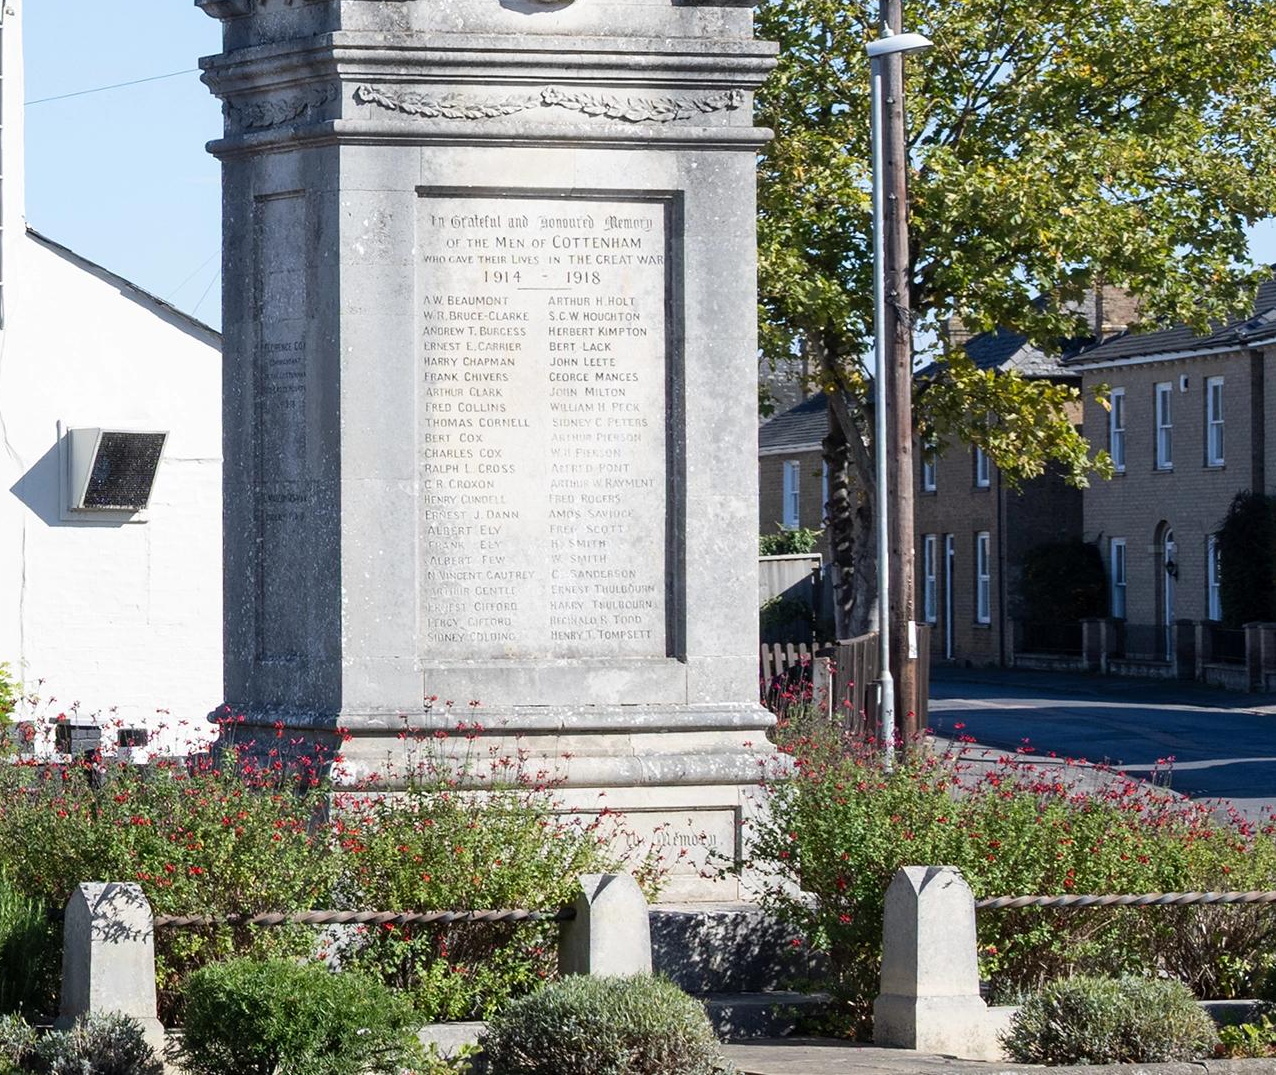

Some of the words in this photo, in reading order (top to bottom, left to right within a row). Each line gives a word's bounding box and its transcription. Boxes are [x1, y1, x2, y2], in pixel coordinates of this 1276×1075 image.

[451, 214, 501, 228] Grateful
[508, 214, 529, 228] and
[539, 214, 595, 228] Honoured
[604, 214, 654, 232] Memory
[467, 235, 490, 249] THE
[552, 235, 642, 249] COTTENHAM
[423, 254, 446, 265] WHO
[449, 254, 474, 265] GAVE
[477, 254, 507, 265] THEIR
[512, 254, 540, 265] LIVES
[569, 254, 593, 265] THE
[596, 254, 632, 265] GREAT
[635, 254, 664, 265] WAR
[484, 270, 522, 284] 1914
[567, 271, 602, 285] 1918
[447, 295, 509, 306] BEAUMONT
[548, 296, 591, 306] ARTHUR
[608, 296, 637, 306] HOLT
[449, 311, 530, 321] BRUCE-CLARKE
[583, 311, 641, 322] HOUGHTON
[422, 326, 465, 336] ANDREW
[480, 326, 527, 336] BURGESS
[549, 326, 594, 337] HERBERT
[598, 326, 648, 337] KIMPTON
[424, 341, 461, 351] ERNEST
[478, 341, 522, 351] CARRIER
[549, 342, 575, 352] BERT
[583, 342, 612, 352] LACK
[424, 357, 458, 367] HARRY
[463, 357, 516, 367] CHAPMAN
[549, 357, 578, 367] JOHN
[583, 357, 616, 367] LEETE
[424, 371, 459, 382] FRANK
[464, 371, 509, 382] CHIVERS
[549, 372, 589, 382] GEORGE
[426, 387, 464, 397] ARTHUR
[469, 387, 504, 397] CLARK
[549, 387, 578, 397] JOHN
[585, 387, 626, 397] MILTON
[425, 402, 452, 413] FRED
[458, 402, 507, 413] COLLINS
[550, 402, 594, 413] WILLIAM
[612, 402, 641, 413] PECK
[425, 417, 473, 428] THOMAS
[478, 417, 530, 428] CORNELL
[552, 418, 592, 428] SIDNEY
[607, 418, 649, 428] PETERS
[425, 433, 451, 443] BERT
[459, 433, 483, 443] COX
[424, 448, 474, 458] CHARLES
[479, 448, 502, 458] COX
[425, 463, 459, 473] RALPH
[478, 463, 516, 473] CROSS
[599, 463, 630, 473] PONT
[448, 478, 495, 489] CROXON
[424, 494, 457, 505] HENRY
[549, 494, 575, 504] FRED
[425, 510, 465, 520] ERNEST
[487, 510, 520, 520] DANN
[548, 509, 582, 519] AMOS
[427, 525, 473, 535] ALBERT
[480, 525, 502, 535] ELY
[586, 524, 624, 534] SCOTT
[480, 540, 502, 549] ELY
[568, 540, 607, 549] SMITH
[429, 555, 474, 565] ALBERT
[482, 555, 506, 565] FEW
[569, 554, 608, 564] SMITH
[570, 569, 637, 580] SANDERSON
[551, 585, 590, 595] ERNEST
[612, 615, 642, 625] TODD
[428, 632, 465, 642] SIDNEY
[551, 630, 583, 641] HENRY
[599, 630, 652, 641] TOMPSETT
